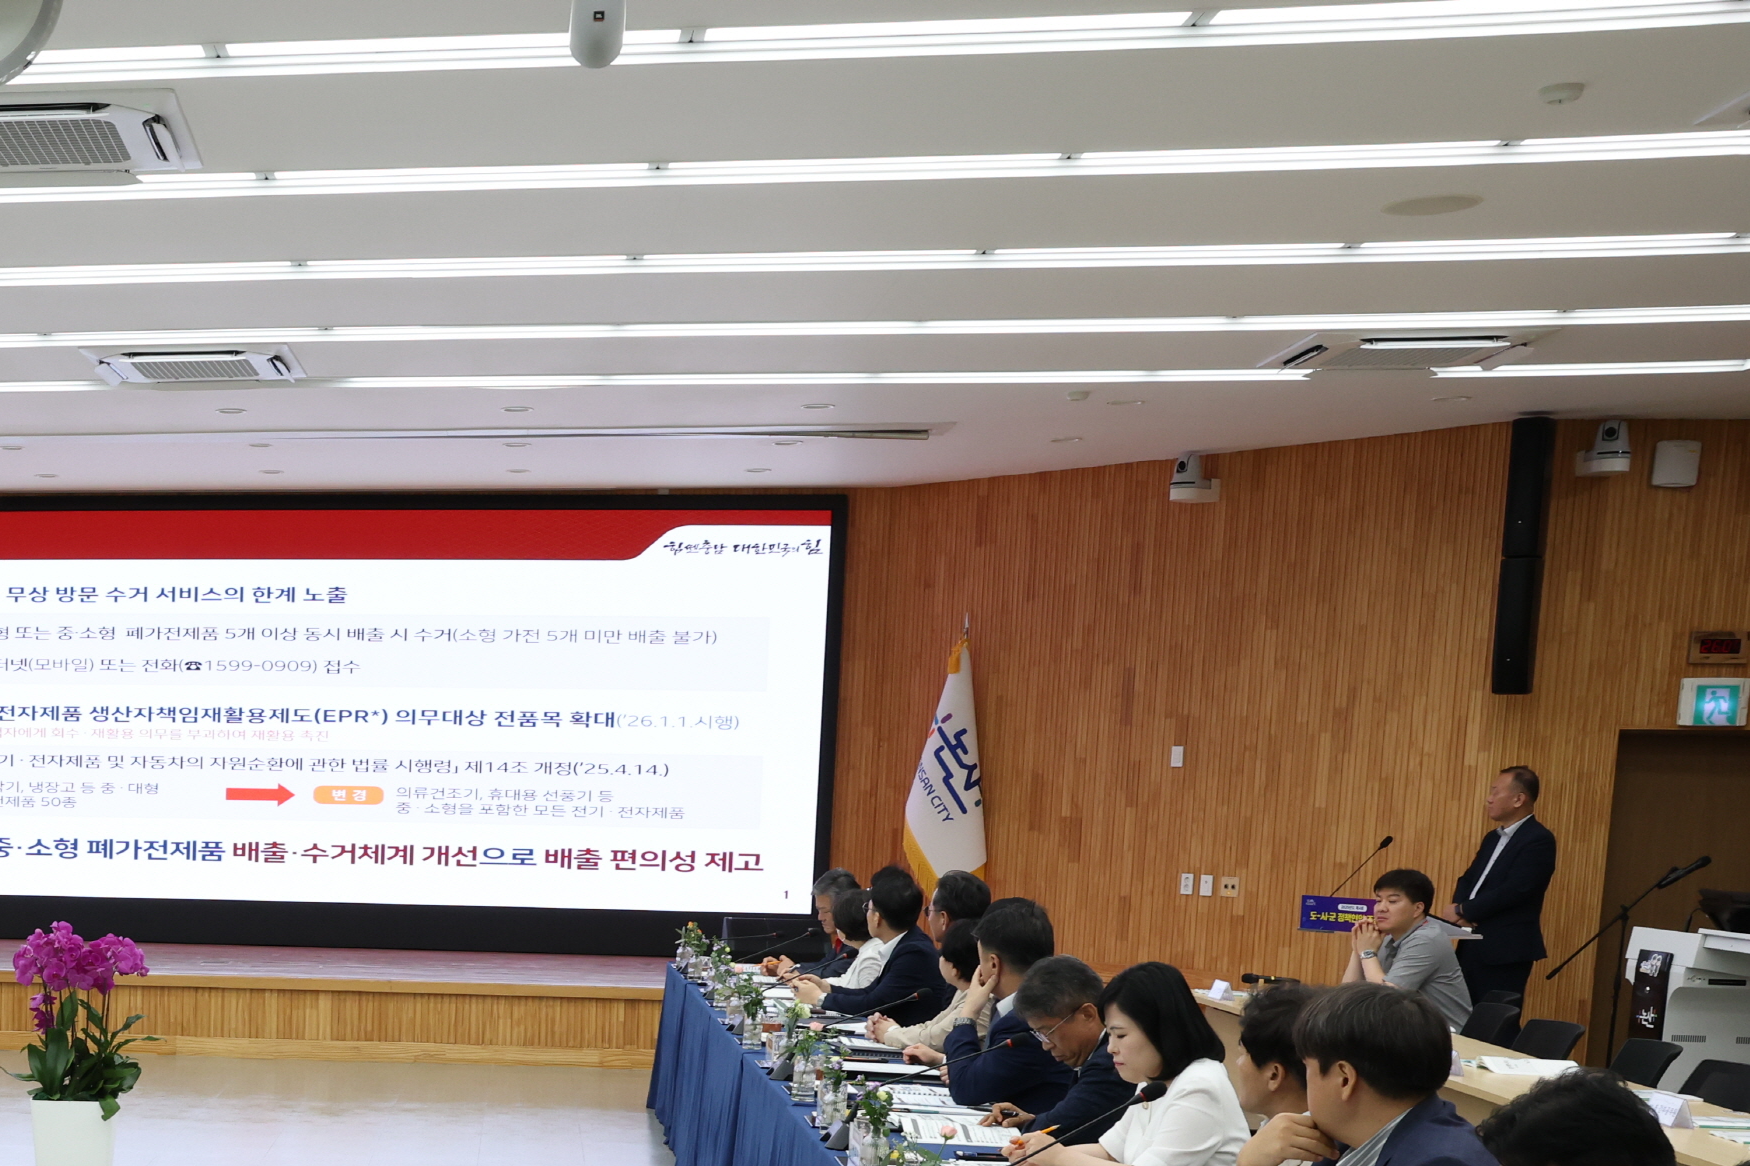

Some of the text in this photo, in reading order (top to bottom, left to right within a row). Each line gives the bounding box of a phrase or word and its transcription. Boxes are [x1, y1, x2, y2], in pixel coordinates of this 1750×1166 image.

[6, 586, 50, 603] 무상
[55, 586, 99, 603] 방문
[105, 586, 148, 603] 수거
[155, 586, 244, 603] 서비스의
[252, 586, 296, 604] 한계
[303, 586, 348, 604] 노출
[14, 626, 49, 641] 또는
[126, 626, 218, 641] 폐가전제품
[225, 627, 255, 641] 5개
[261, 627, 297, 642] 이상
[303, 627, 340, 642] 동시
[347, 627, 383, 642] 배출
[390, 627, 408, 641] 시
[414, 628, 496, 643] 수거(소형
[502, 628, 540, 644] 가전
[547, 629, 578, 643] 5개
[584, 629, 623, 645] 미만
[628, 629, 667, 645] 배출
[672, 630, 718, 645] 불가)
[99, 658, 136, 673] 또는
[324, 659, 360, 675] 접수
[395, 708, 488, 727] 의무대상
[494, 710, 563, 728] 전품목
[29, 754, 100, 769] 전자제품
[107, 755, 124, 769] 및
[130, 755, 204, 770] 자동차의
[209, 756, 303, 772] 자원순환에
[309, 757, 347, 772] 관한
[352, 758, 388, 773] 법률
[464, 760, 526, 774] 제14조
[41, 796, 77, 809] 50종
[86, 838, 226, 862] 폐가전제품
[421, 845, 538, 868] 개선으로
[544, 847, 603, 871] 배출
[609, 848, 696, 873] 편의성
[704, 851, 764, 874] 제고
